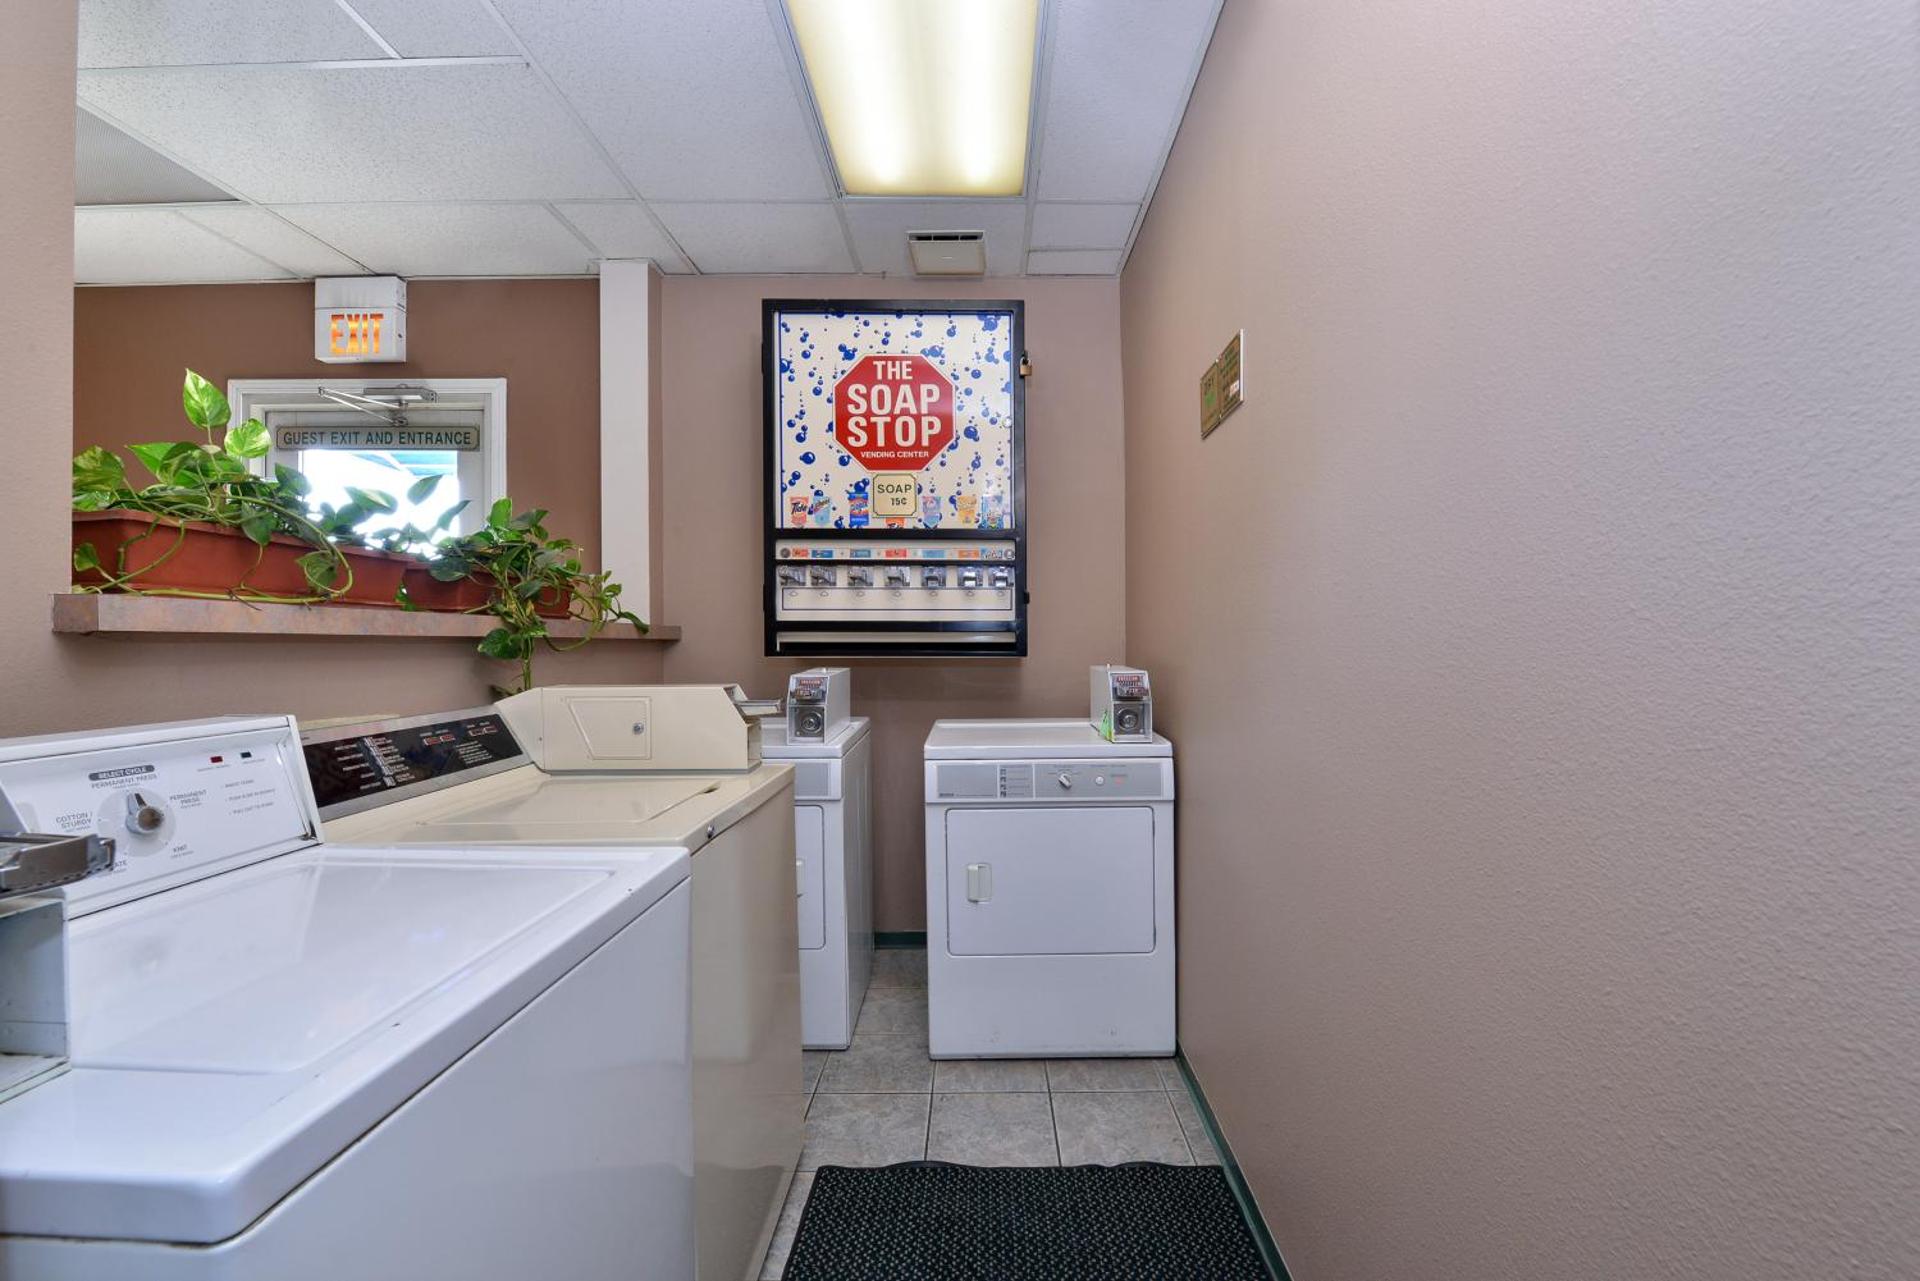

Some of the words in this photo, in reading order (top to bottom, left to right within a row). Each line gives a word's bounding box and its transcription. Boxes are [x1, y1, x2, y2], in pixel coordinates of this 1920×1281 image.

[331, 313, 384, 354] EXIT
[873, 361, 913, 380] THE
[847, 384, 940, 415] SOAP
[283, 431, 325, 445] GUEST
[330, 431, 360, 445] EXIT
[365, 431, 393, 445] AND
[399, 431, 471, 445] ENTRANCE
[847, 416, 941, 447] STOP
[877, 484, 912, 494] SOAP
